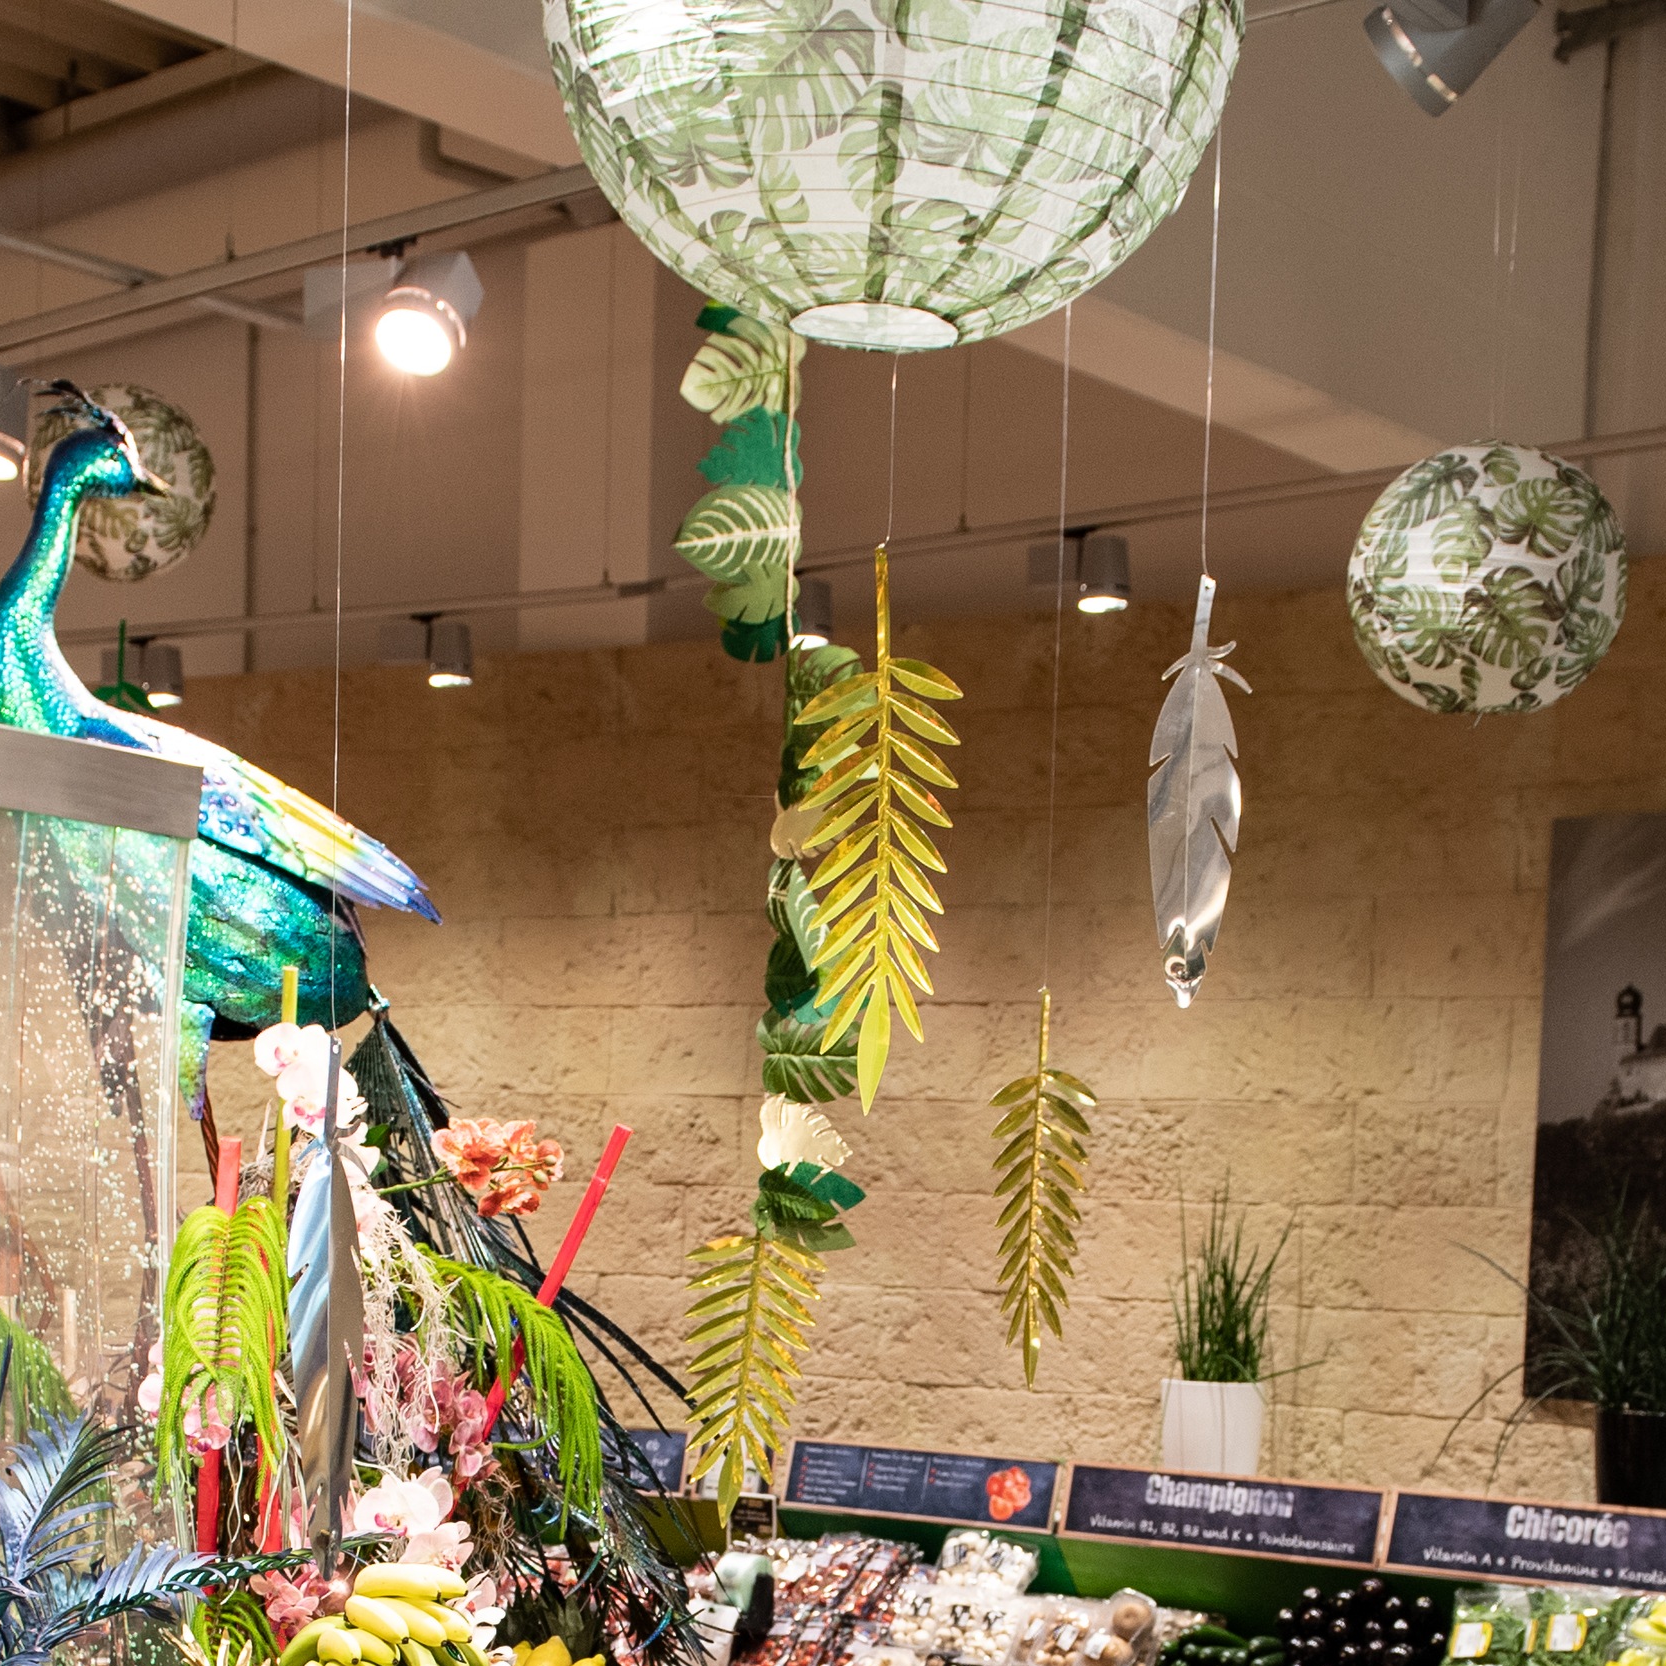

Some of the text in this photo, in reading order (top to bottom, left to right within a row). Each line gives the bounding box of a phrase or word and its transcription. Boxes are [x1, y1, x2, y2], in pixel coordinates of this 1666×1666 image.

[1145, 1474, 1294, 1518] Champignon
[1090, 1513, 1134, 1530] Vitamin
[1232, 1529, 1242, 1541] K
[1505, 1505, 1630, 1549] Chicorée
[1423, 1547, 1477, 1566] Vitamin
[1483, 1553, 1492, 1566] A
[1511, 1555, 1599, 1579] Provitamine
